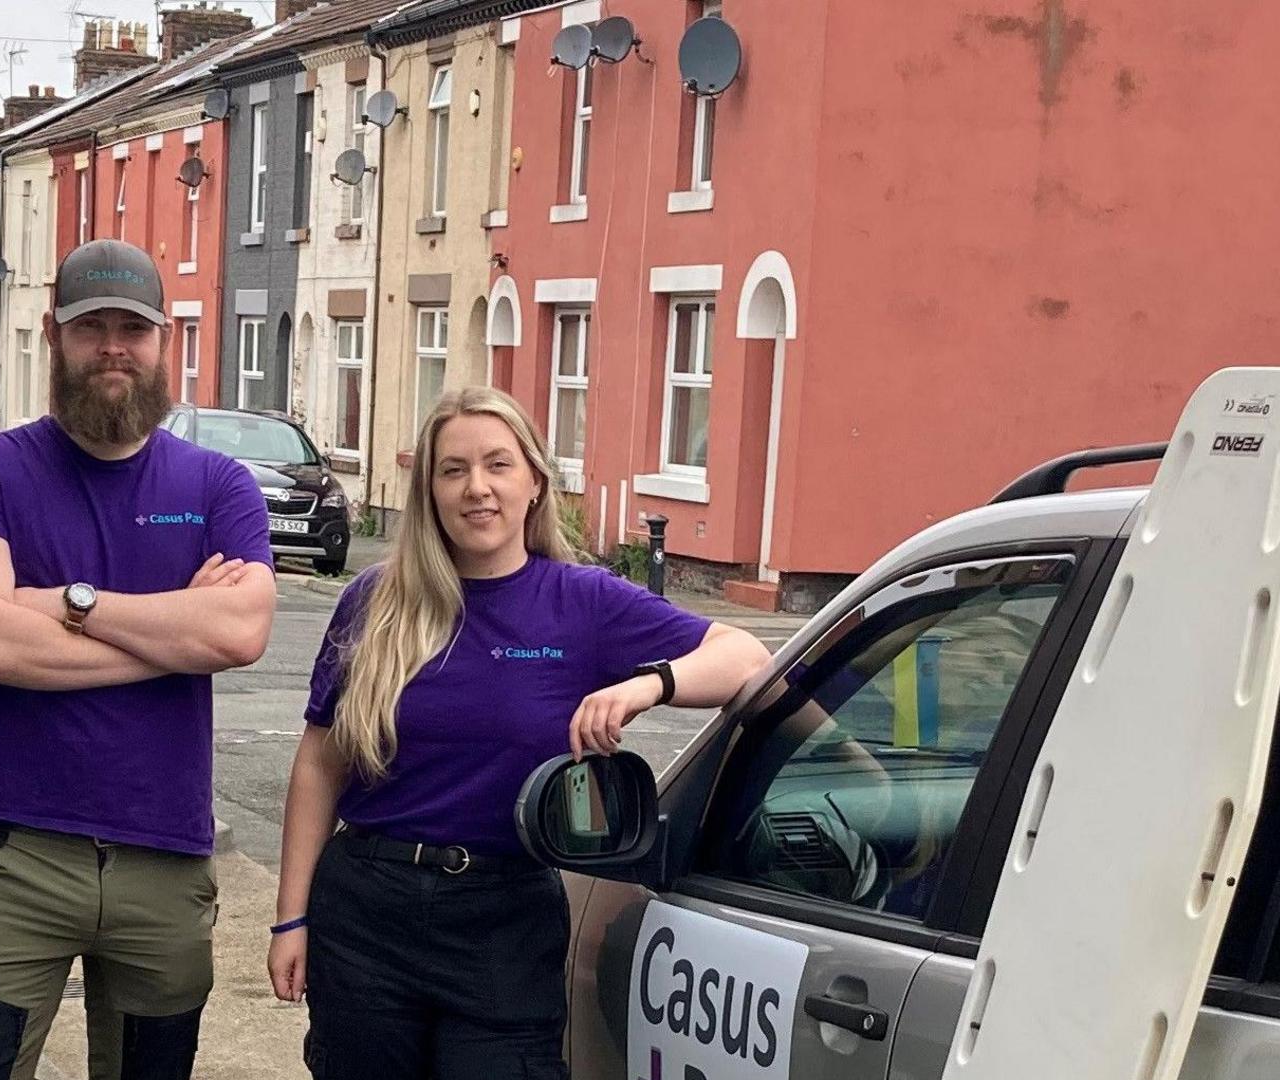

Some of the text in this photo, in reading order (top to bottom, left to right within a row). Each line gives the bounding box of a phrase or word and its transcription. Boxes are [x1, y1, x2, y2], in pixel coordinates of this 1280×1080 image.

[1212, 436, 1265, 452] FERNO
[149, 512, 204, 524] Casus Pax
[287, 520, 305, 532] SXZ
[505, 646, 563, 658] Casus Pax
[640, 926, 780, 1068] Casus
